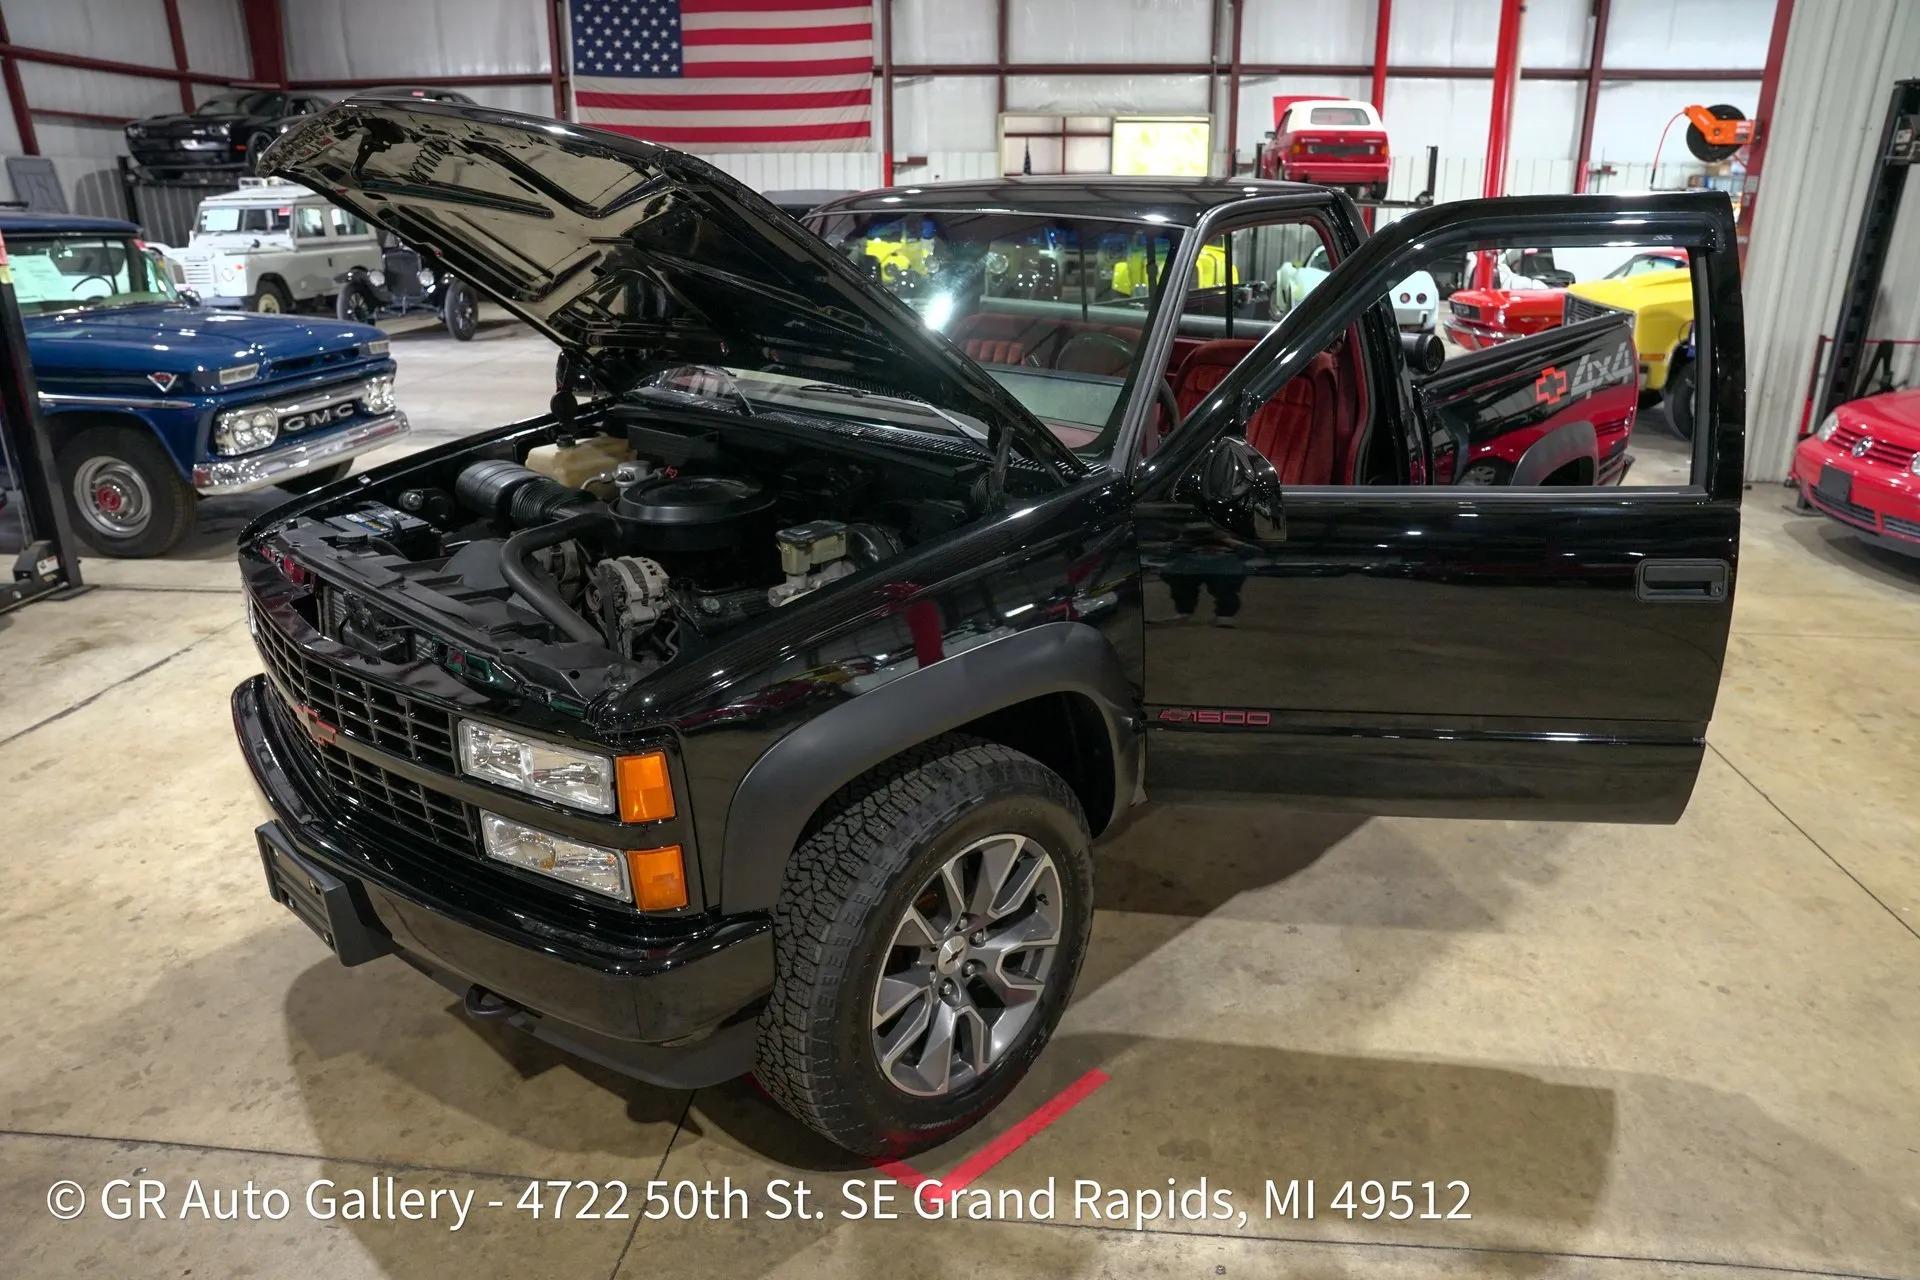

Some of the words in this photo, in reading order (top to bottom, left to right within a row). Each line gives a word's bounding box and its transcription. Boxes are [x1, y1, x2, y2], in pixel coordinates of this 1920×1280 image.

[1571, 342, 1633, 400] 4x4
[283, 403, 354, 431] GMC
[1192, 710, 1270, 725] 1500
